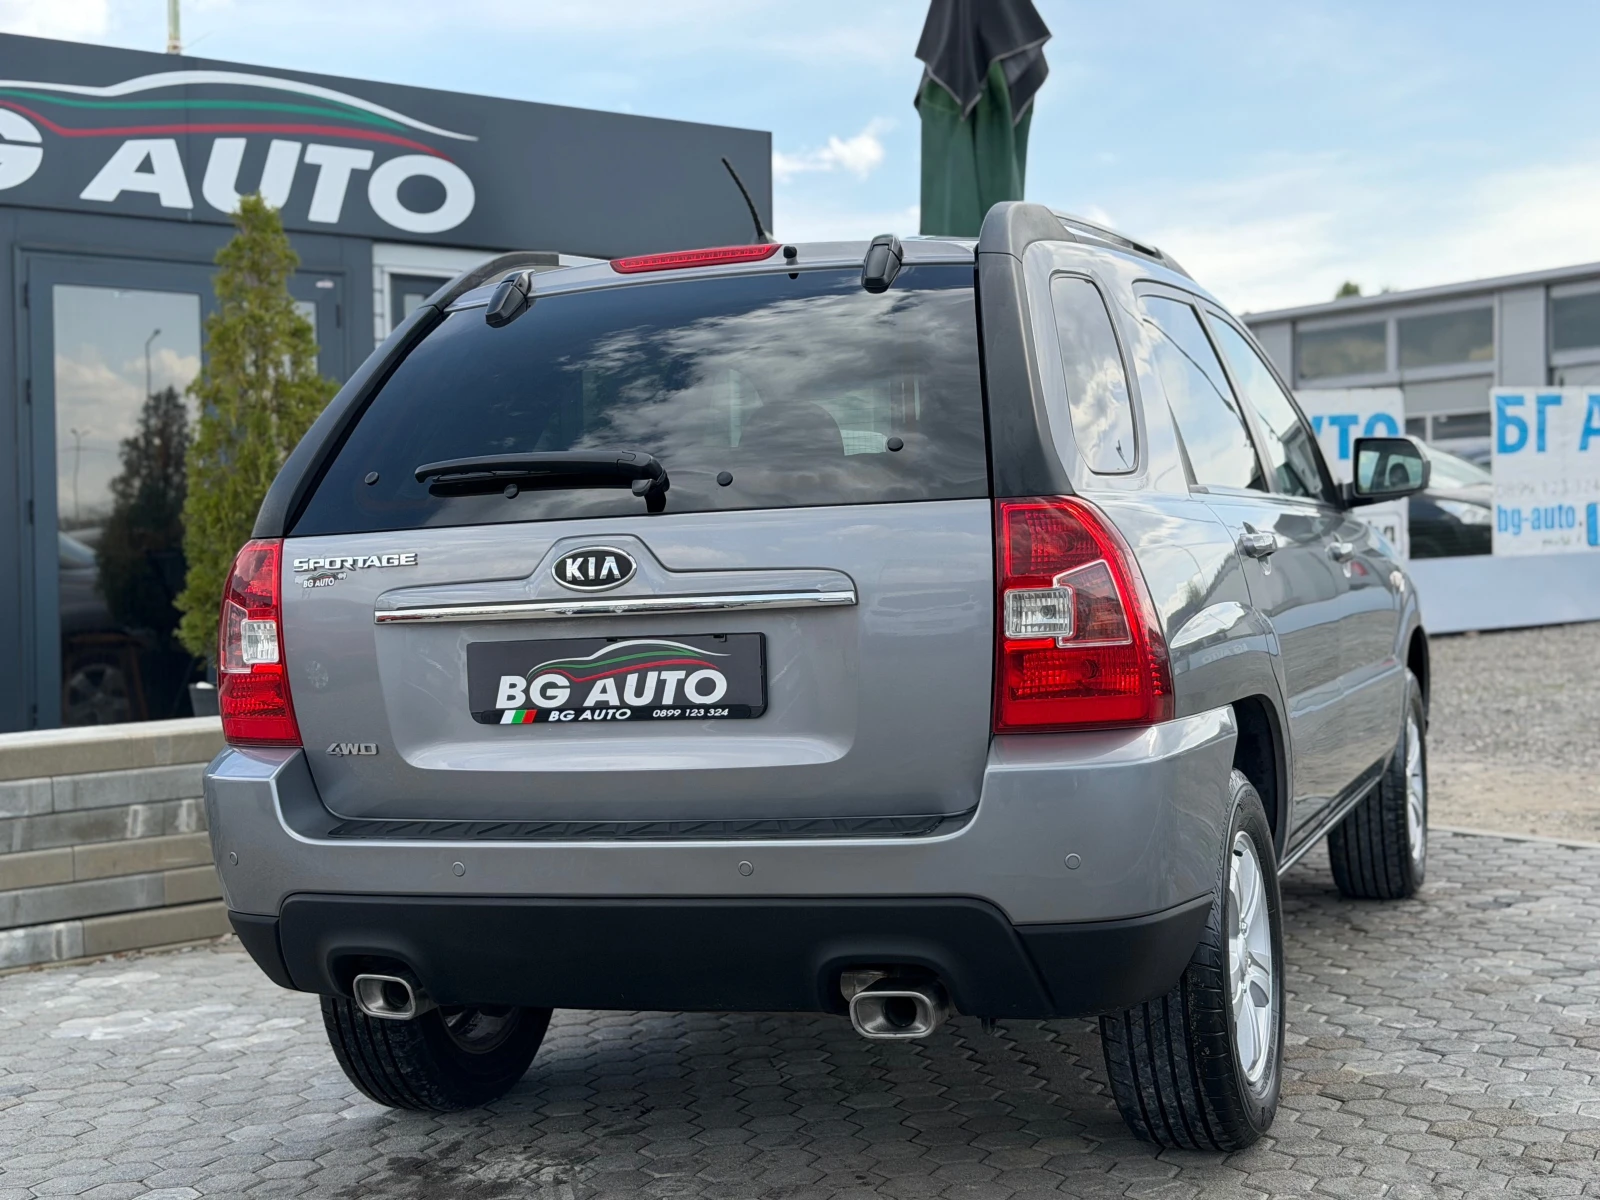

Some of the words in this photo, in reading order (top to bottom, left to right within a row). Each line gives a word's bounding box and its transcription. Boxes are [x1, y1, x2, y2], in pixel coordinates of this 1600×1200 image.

[79, 137, 476, 233] AUTO
[1496, 395, 1562, 454] БГ
[293, 553, 417, 572] SPORTAGE
[565, 556, 621, 581] KIA
[303, 580, 314, 588] BG
[315, 577, 335, 587] AUTO
[496, 674, 571, 708] BG
[582, 669, 728, 706] AUTO
[548, 710, 575, 721] BG
[578, 709, 631, 720] AUTO
[653, 709, 681, 717] 0899
[707, 708, 729, 716] 324
[326, 743, 378, 757] 4WD
